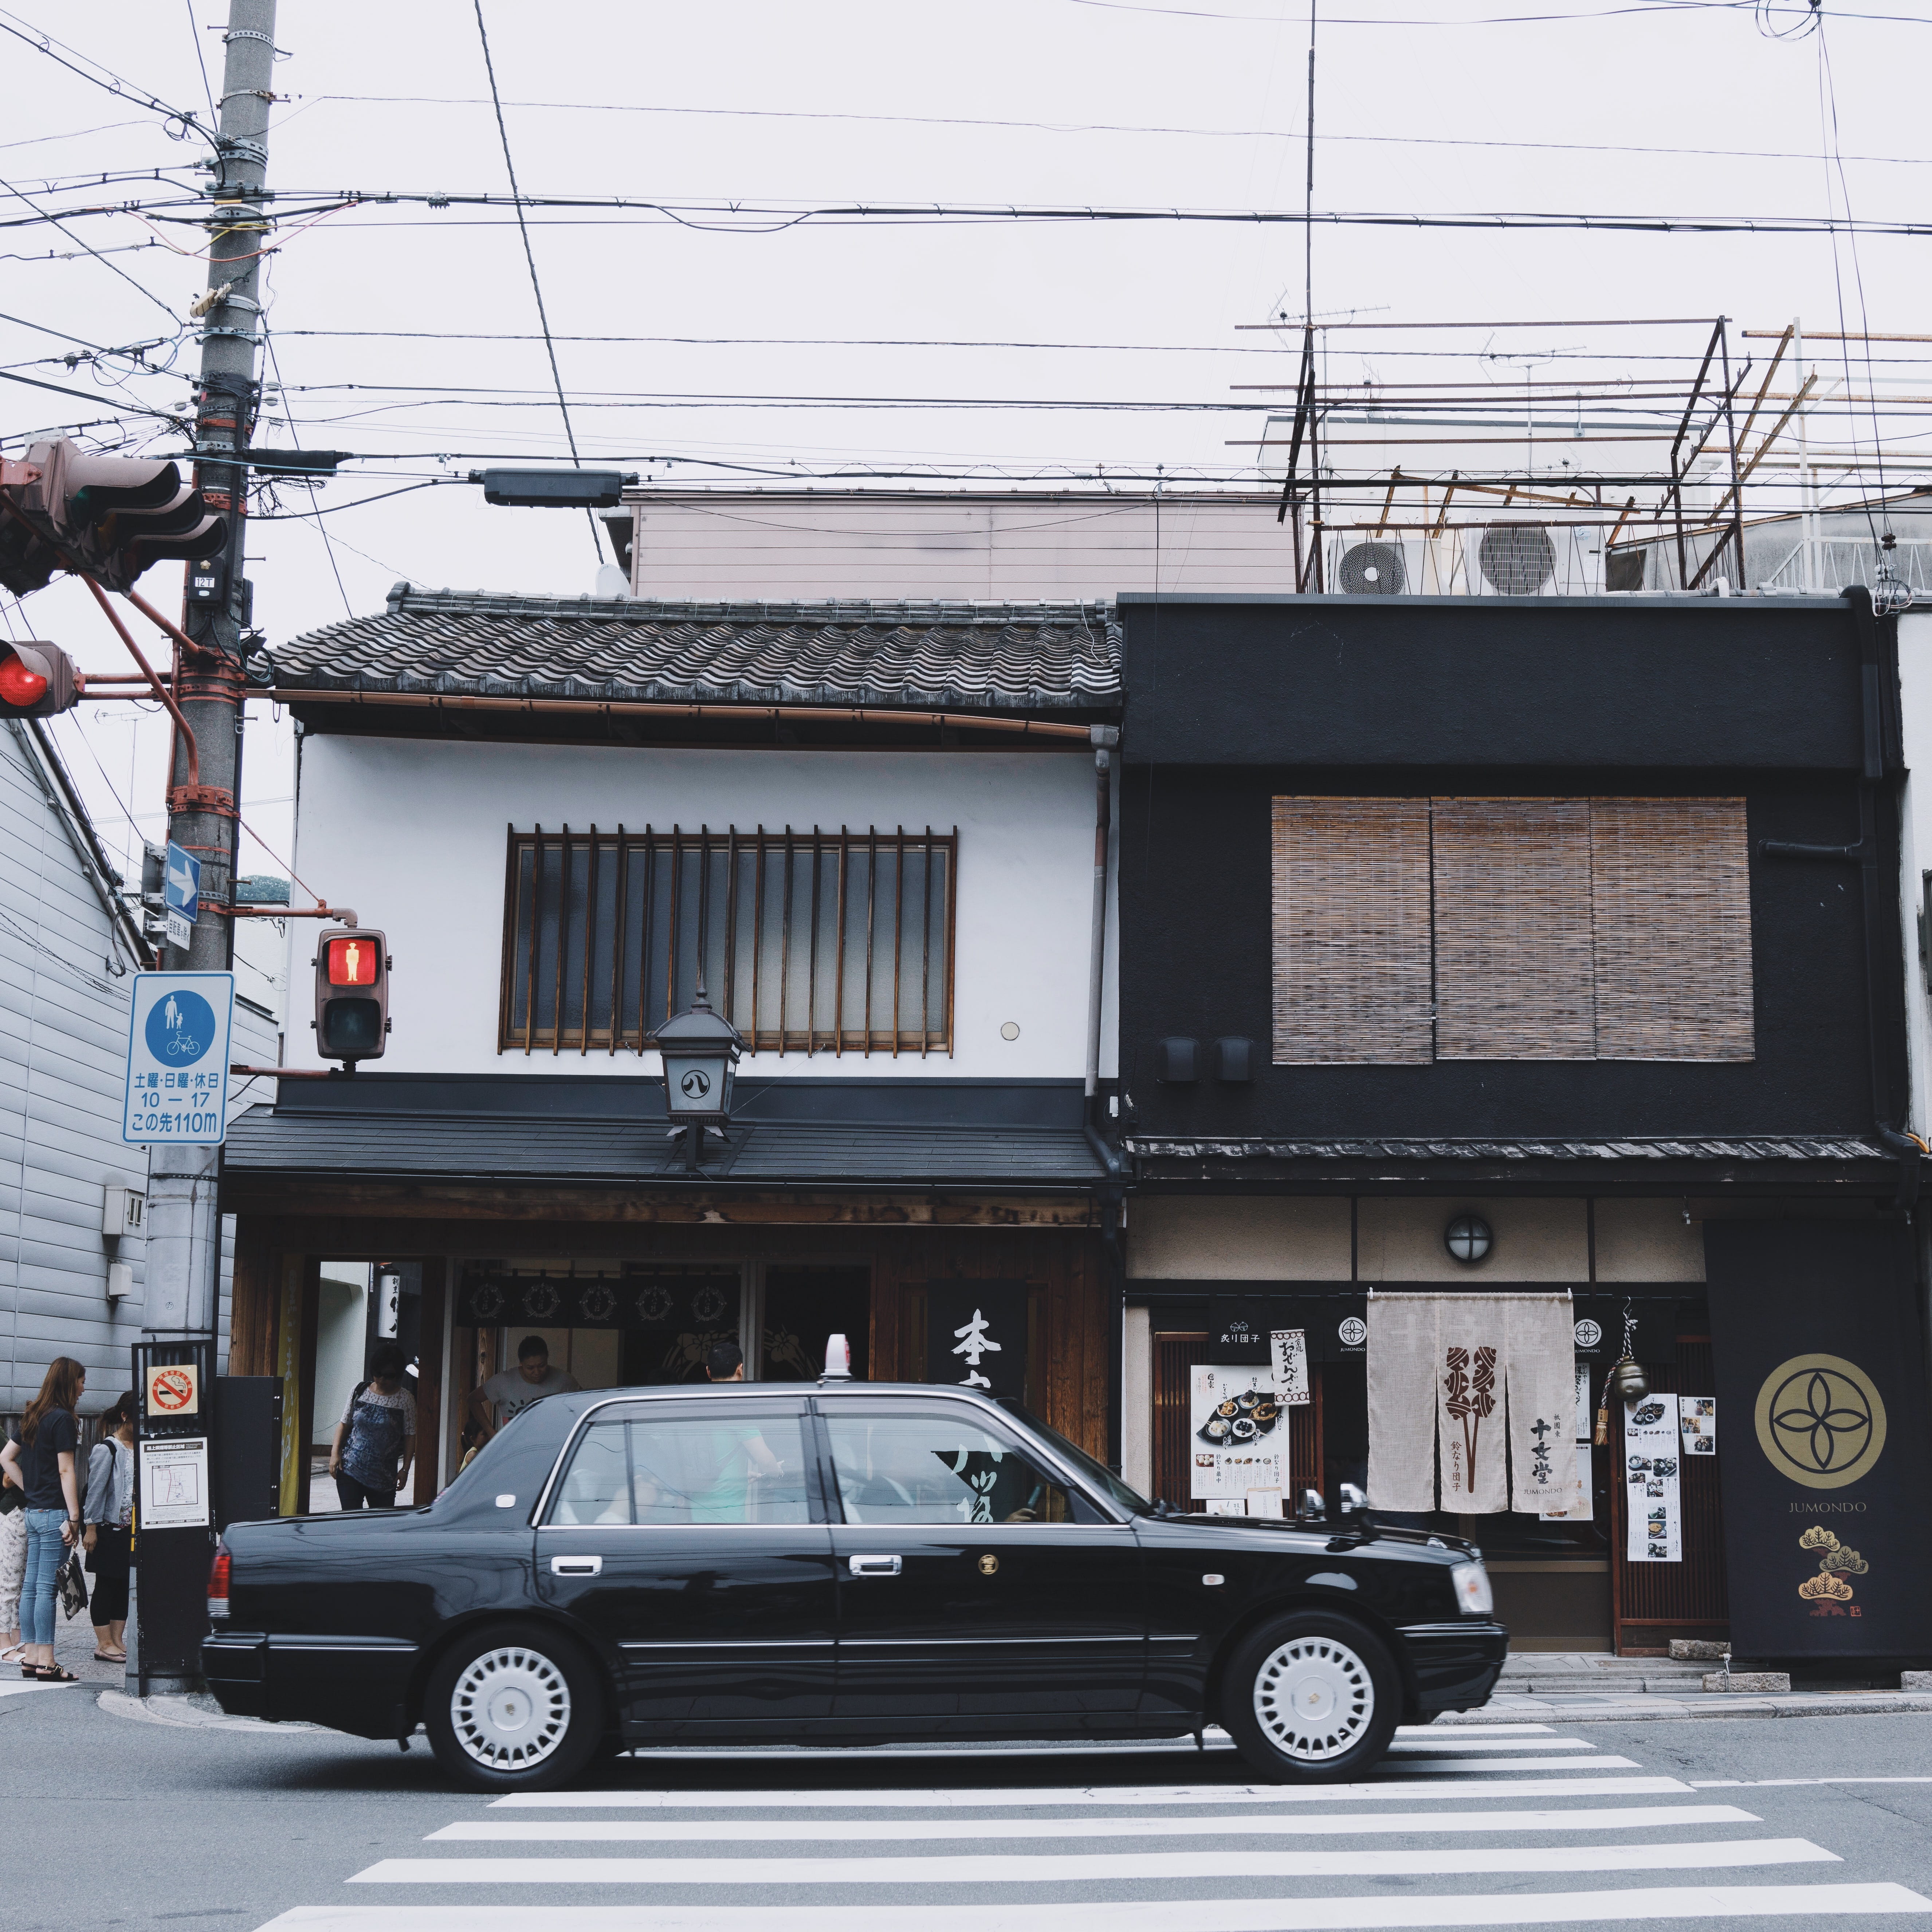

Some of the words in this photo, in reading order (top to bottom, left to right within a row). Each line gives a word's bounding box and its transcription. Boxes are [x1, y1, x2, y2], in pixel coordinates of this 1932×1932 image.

[197, 578, 212, 586] 12T
[134, 1073, 219, 1088] 土曜・日曜・休日
[141, 1092, 160, 1107] 10
[191, 1092, 210, 1107] 17
[132, 1112, 217, 1132] この先110m
[1221, 1334, 1260, 1343] 炙り団子
[1279, 1341, 1298, 1392] おぜんざい
[1450, 1441, 1462, 1492] 鈴なり団子
[1789, 1502, 1866, 1512] JUMONDO
